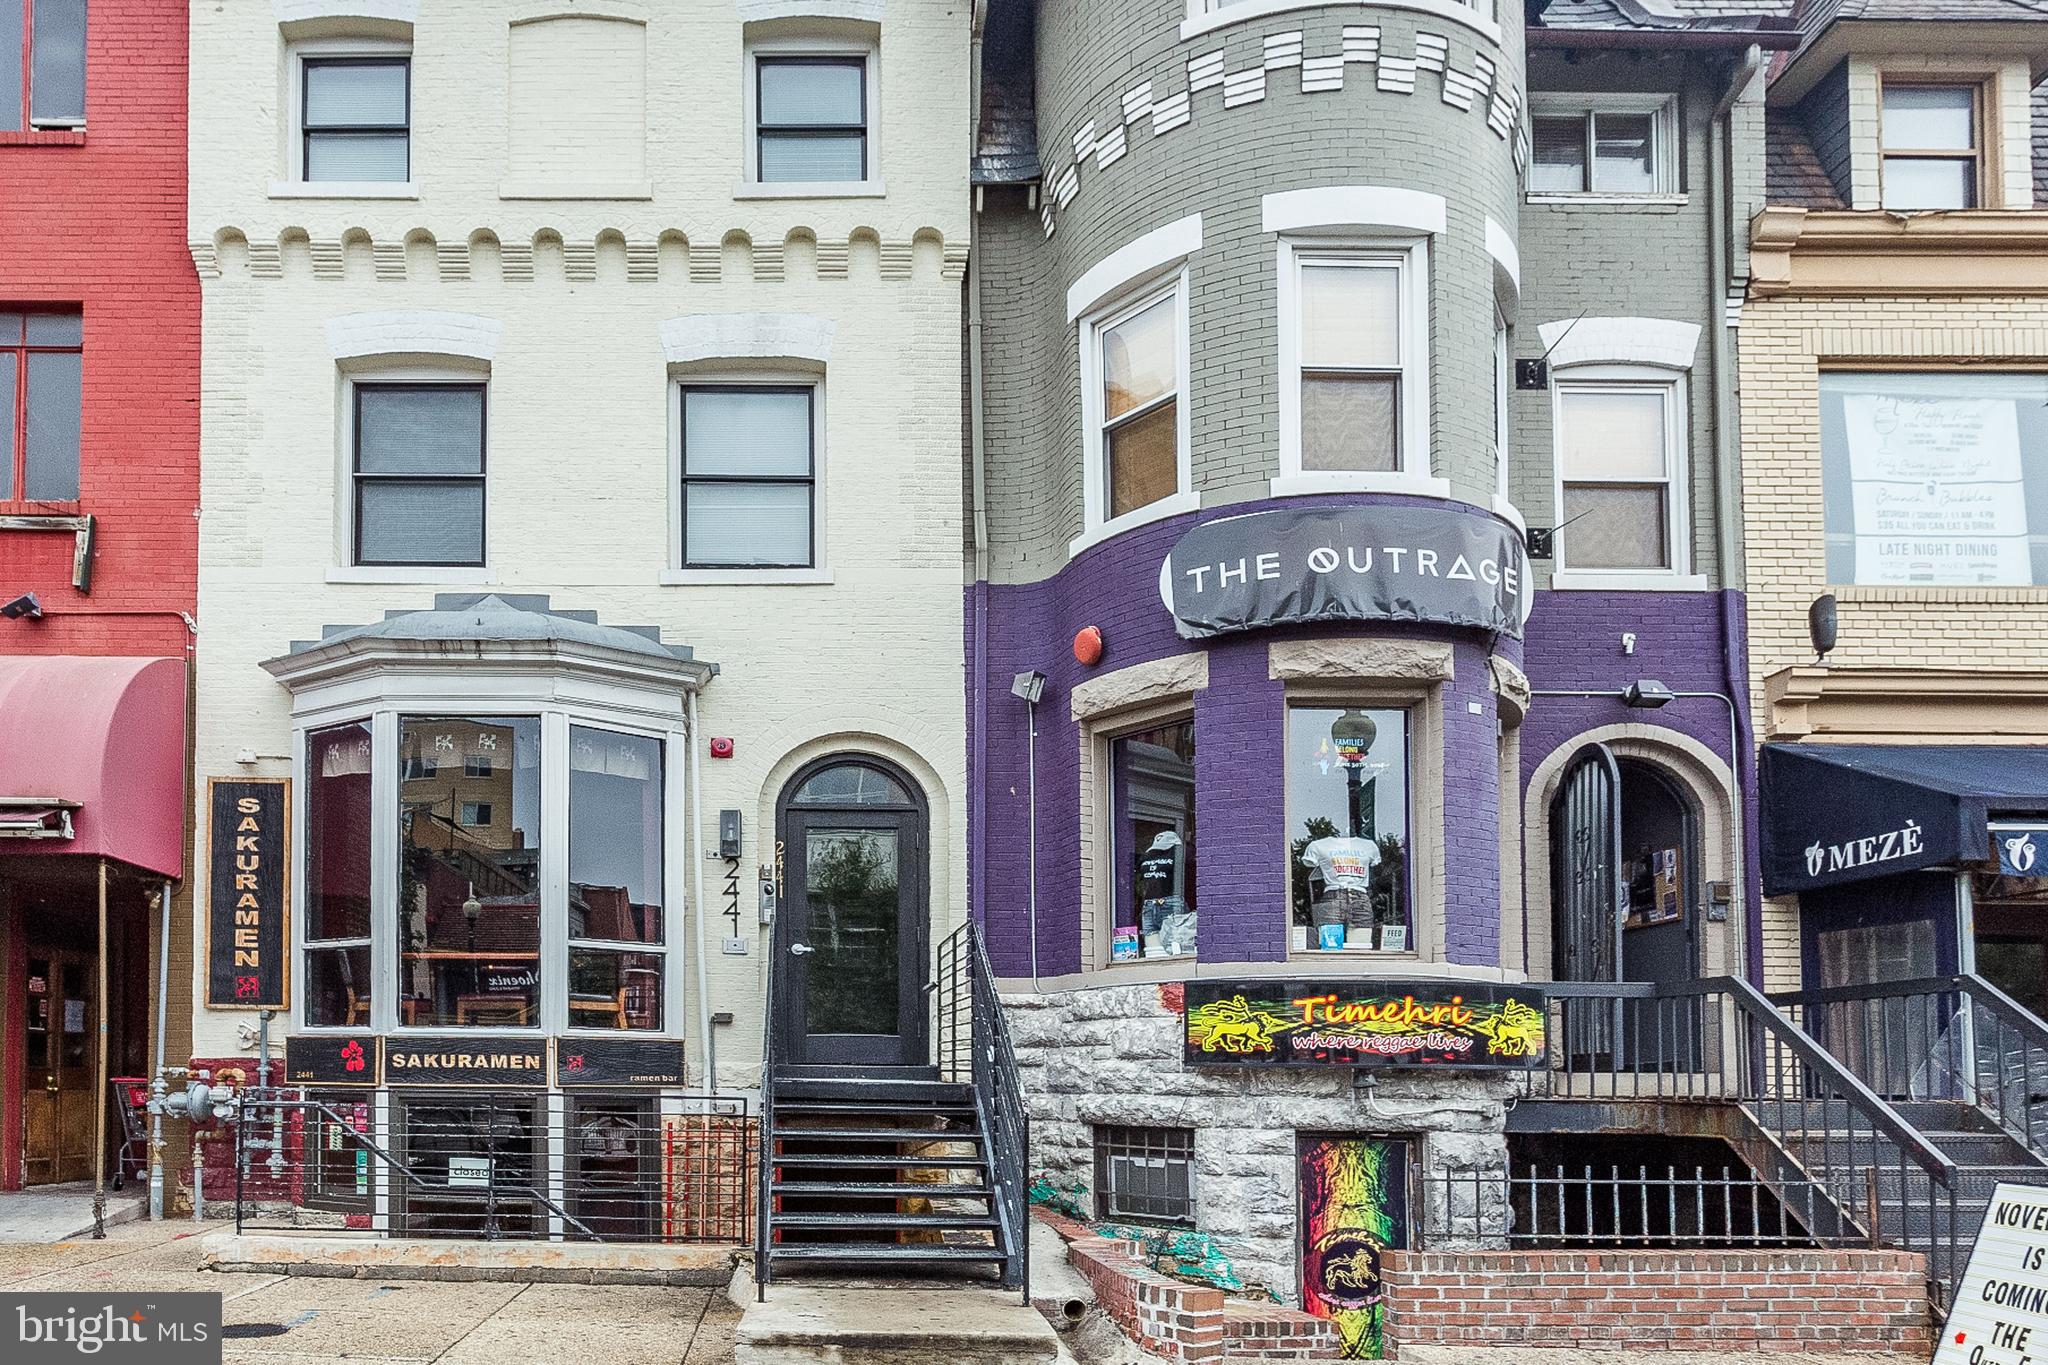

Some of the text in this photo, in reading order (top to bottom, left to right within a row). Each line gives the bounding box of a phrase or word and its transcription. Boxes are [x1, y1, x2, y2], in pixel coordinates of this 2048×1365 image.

[1896, 521, 1910, 530] ALL
[1912, 521, 1926, 530] YOU
[1928, 521, 1945, 531] CAN
[1947, 521, 1961, 530] EAT
[1971, 521, 1997, 531] DRINK
[1878, 542, 1998, 557] LATE NIGHT DINING
[1186, 551, 1282, 593] THE
[1827, 819, 1924, 873] MEZÈ
[234, 797, 261, 968] SAKURAMEN
[776, 840, 786, 900] 2441
[721, 857, 741, 939] 2441
[1387, 929, 1403, 938] FEED
[1293, 993, 1473, 1027] Timehri
[1292, 1031, 1474, 1055] where reggae lives
[296, 1071, 313, 1079] 2441
[391, 1052, 541, 1071] SAKURAMEN
[661, 1074, 678, 1082] bar
[453, 1165, 490, 1178] closed
[1994, 1202, 2048, 1231] NOVE
[2022, 1246, 2046, 1271] IS
[1982, 1280, 2048, 1314] COMIN
[1991, 1321, 2032, 1352] THE
